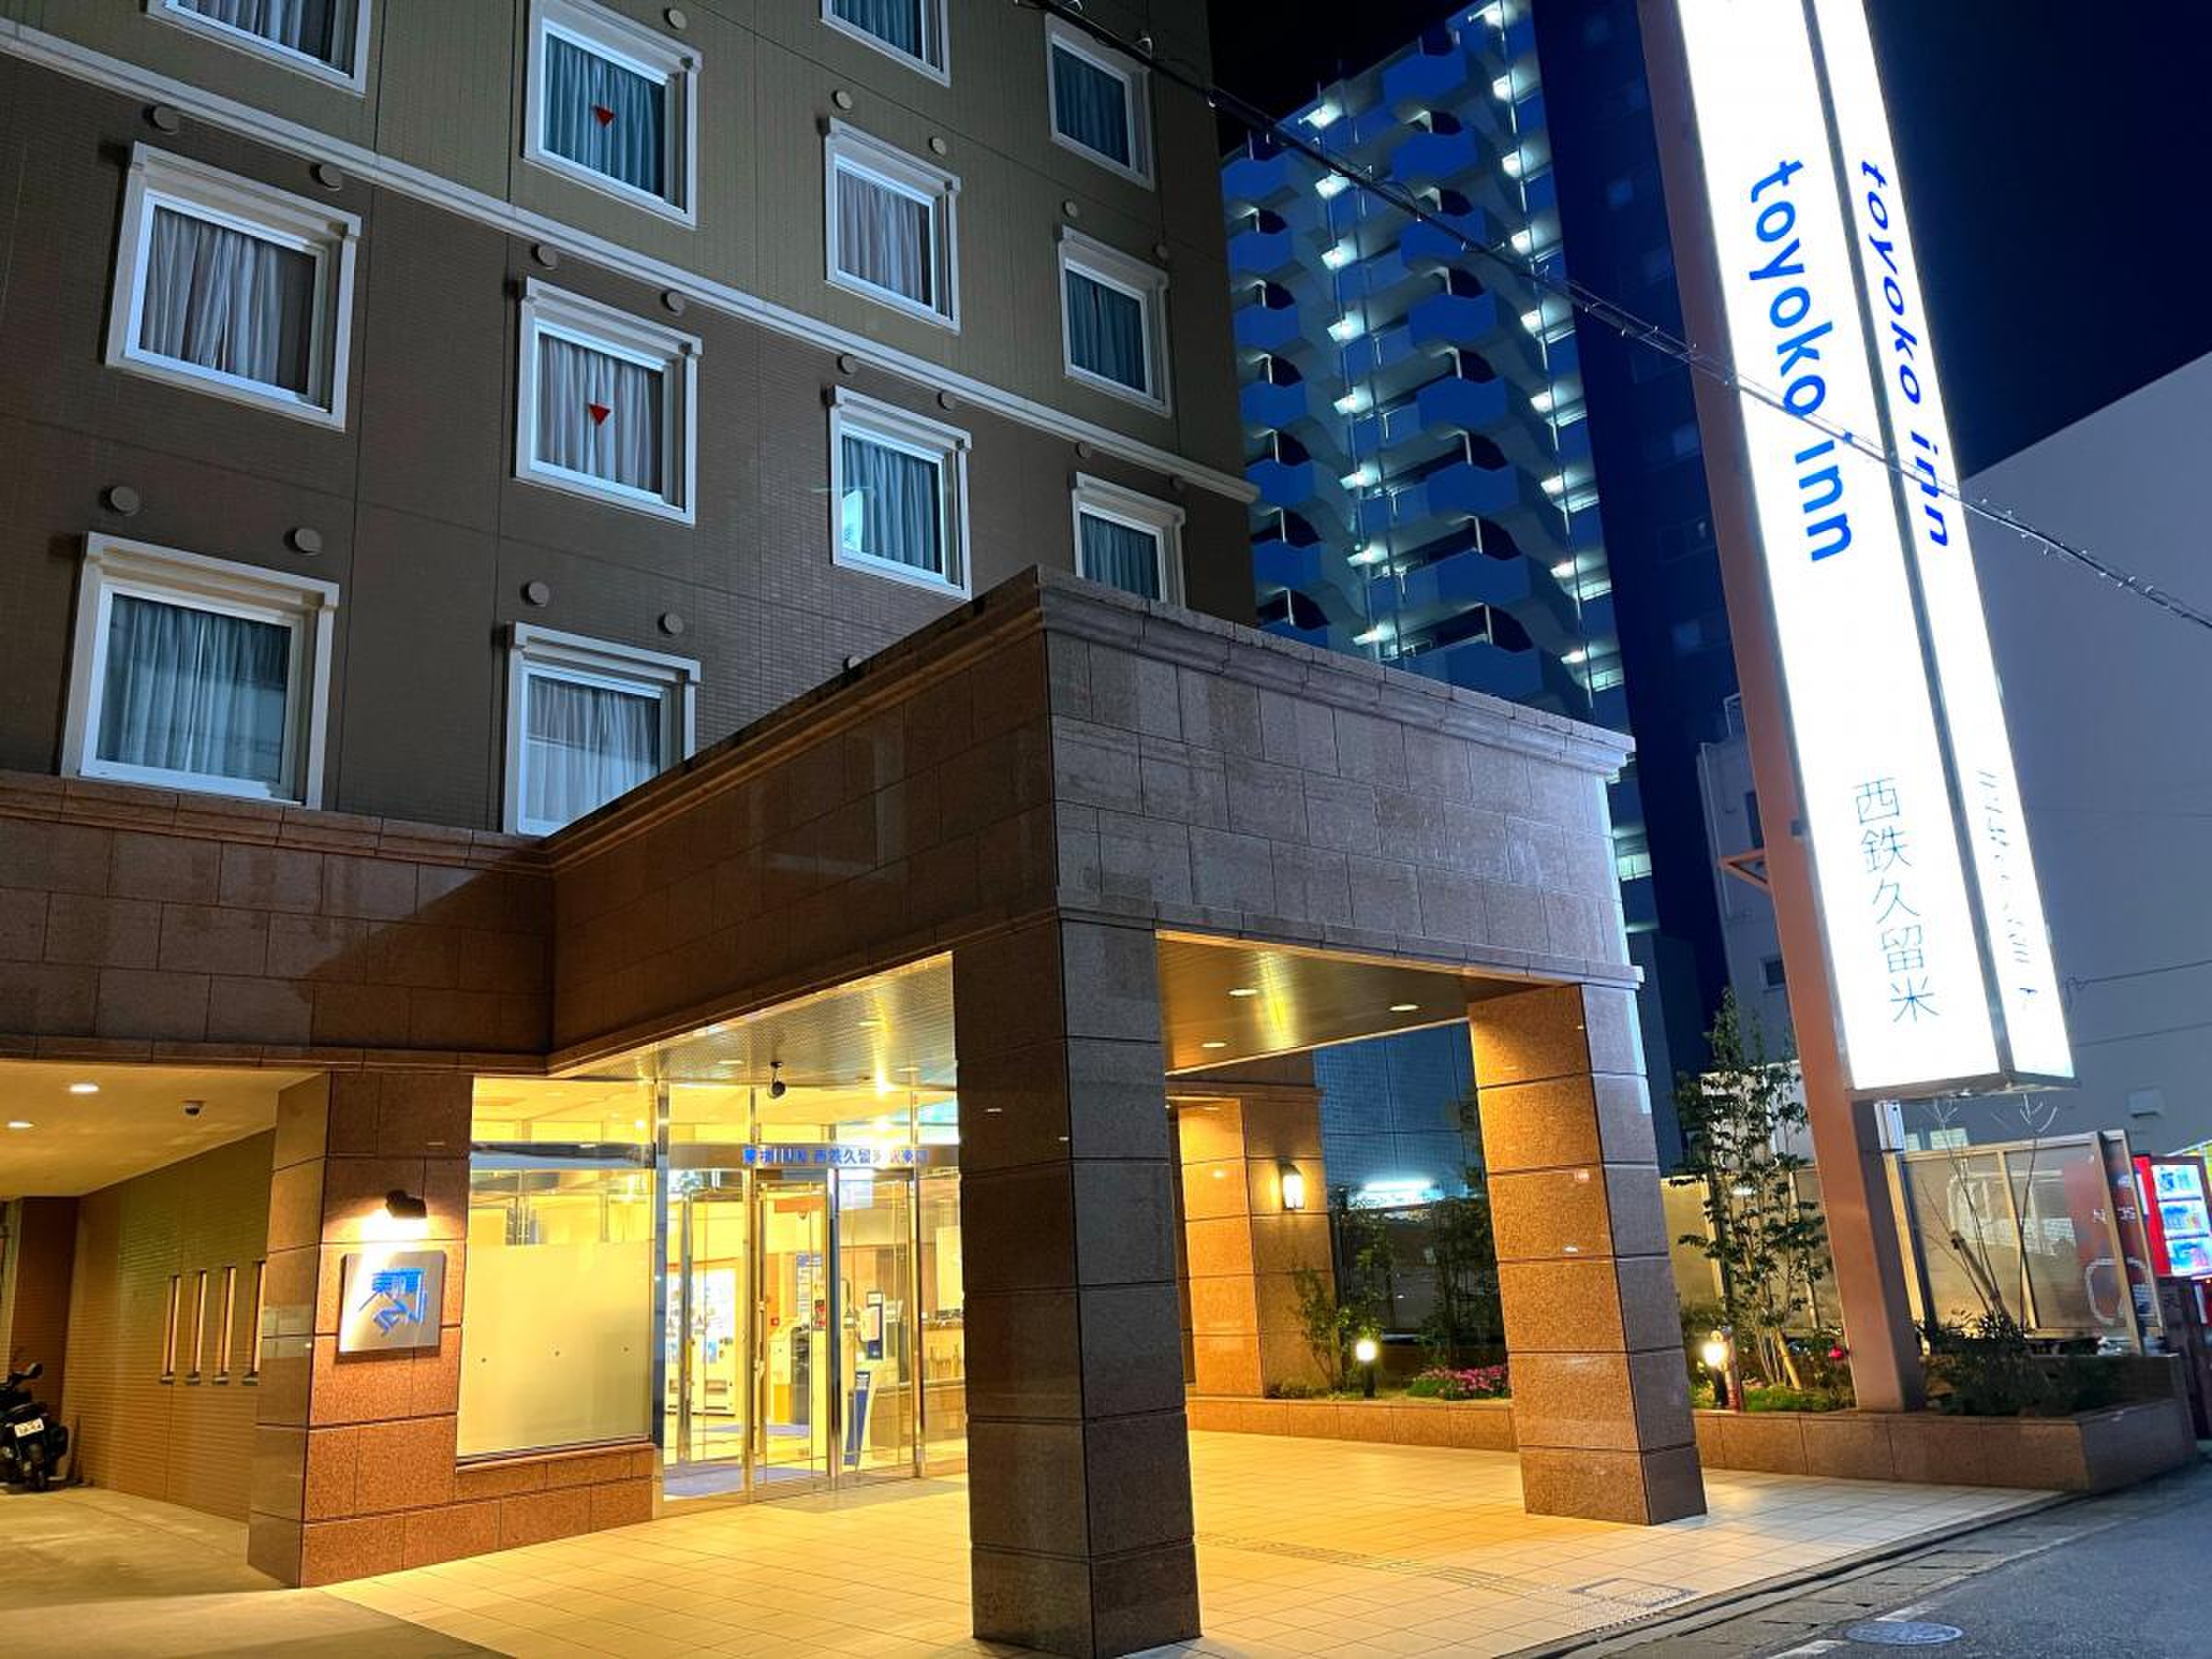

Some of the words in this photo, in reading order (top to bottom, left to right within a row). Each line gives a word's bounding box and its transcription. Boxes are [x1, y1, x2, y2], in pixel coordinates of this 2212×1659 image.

[1748, 159, 1834, 419] toyoko
[1794, 431, 1853, 561] inn
[1860, 160, 1922, 406] toyoko
[1911, 430, 1949, 547] inn
[1853, 777, 1942, 1023] 西鉄久留米
